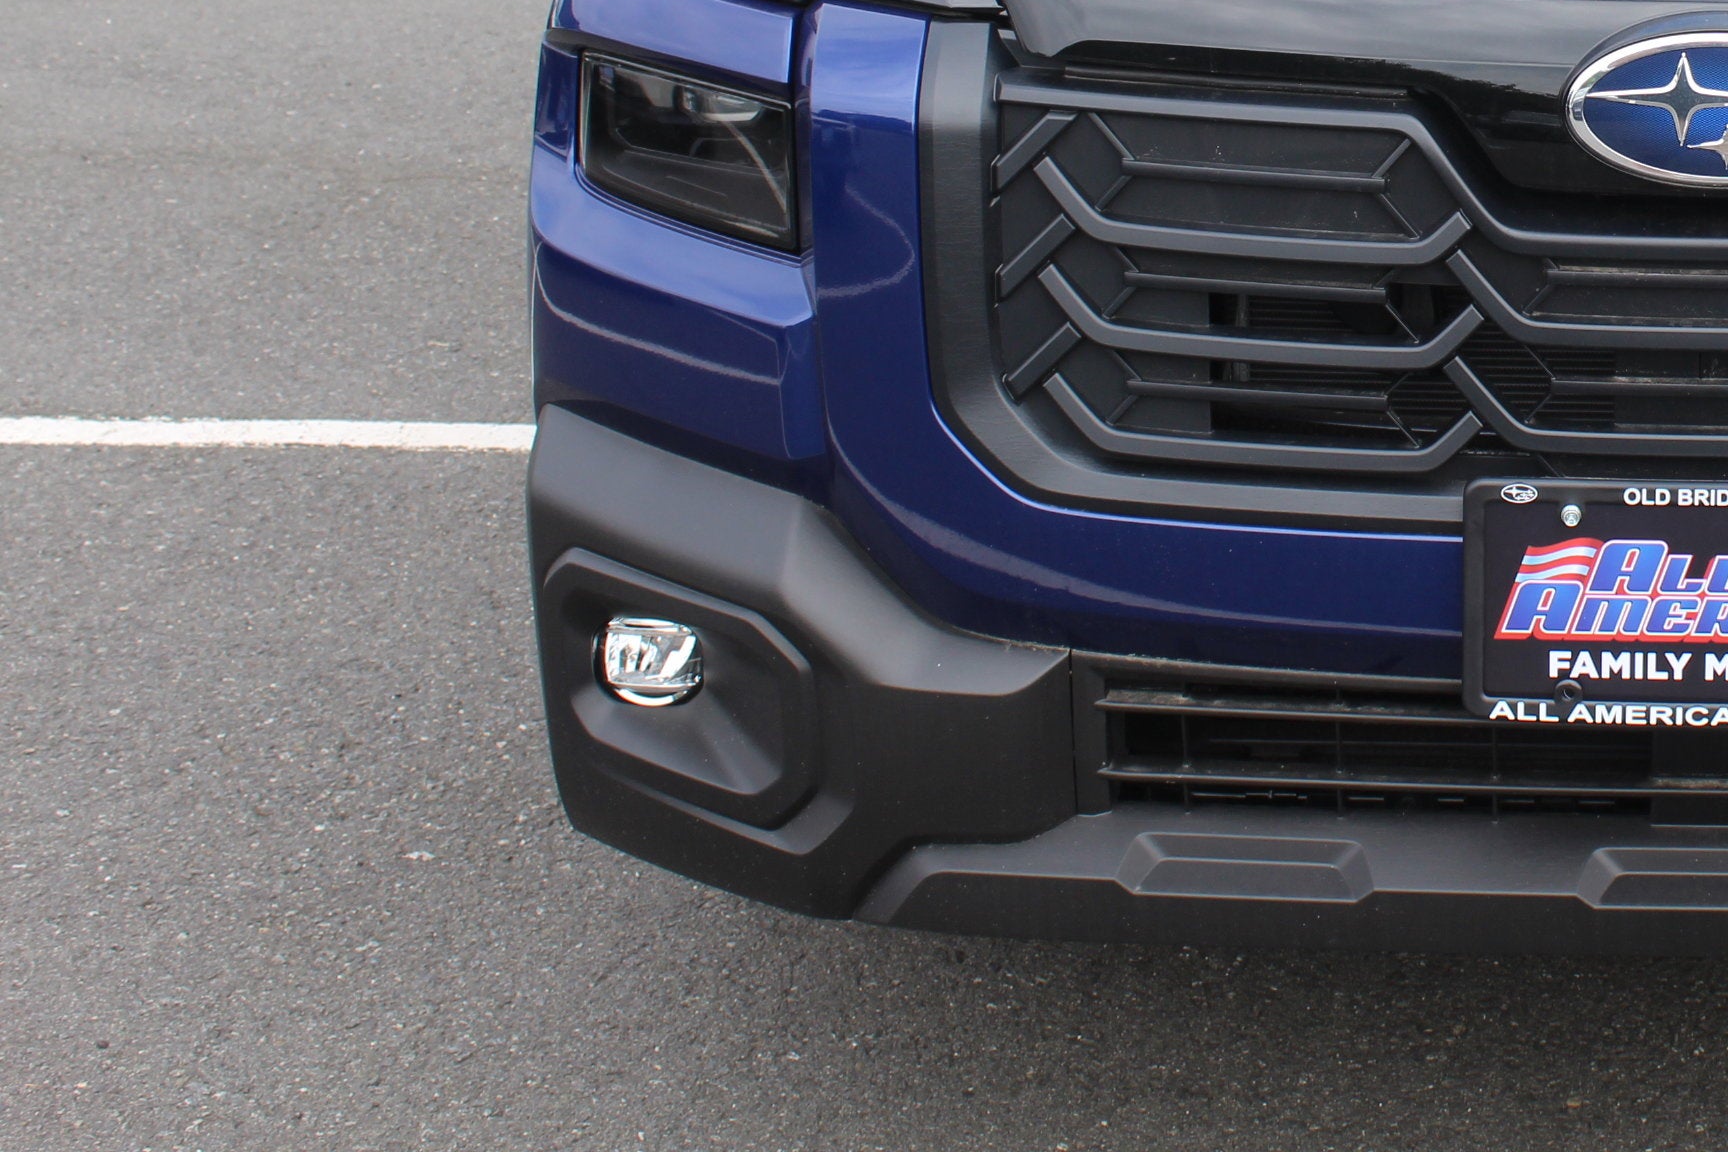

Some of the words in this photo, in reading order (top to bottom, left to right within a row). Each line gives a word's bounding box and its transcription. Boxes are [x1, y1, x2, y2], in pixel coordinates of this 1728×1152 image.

[1623, 487, 1671, 506] OLD
[1548, 651, 1692, 680] FAMILY
[1489, 701, 1560, 723] ALL
